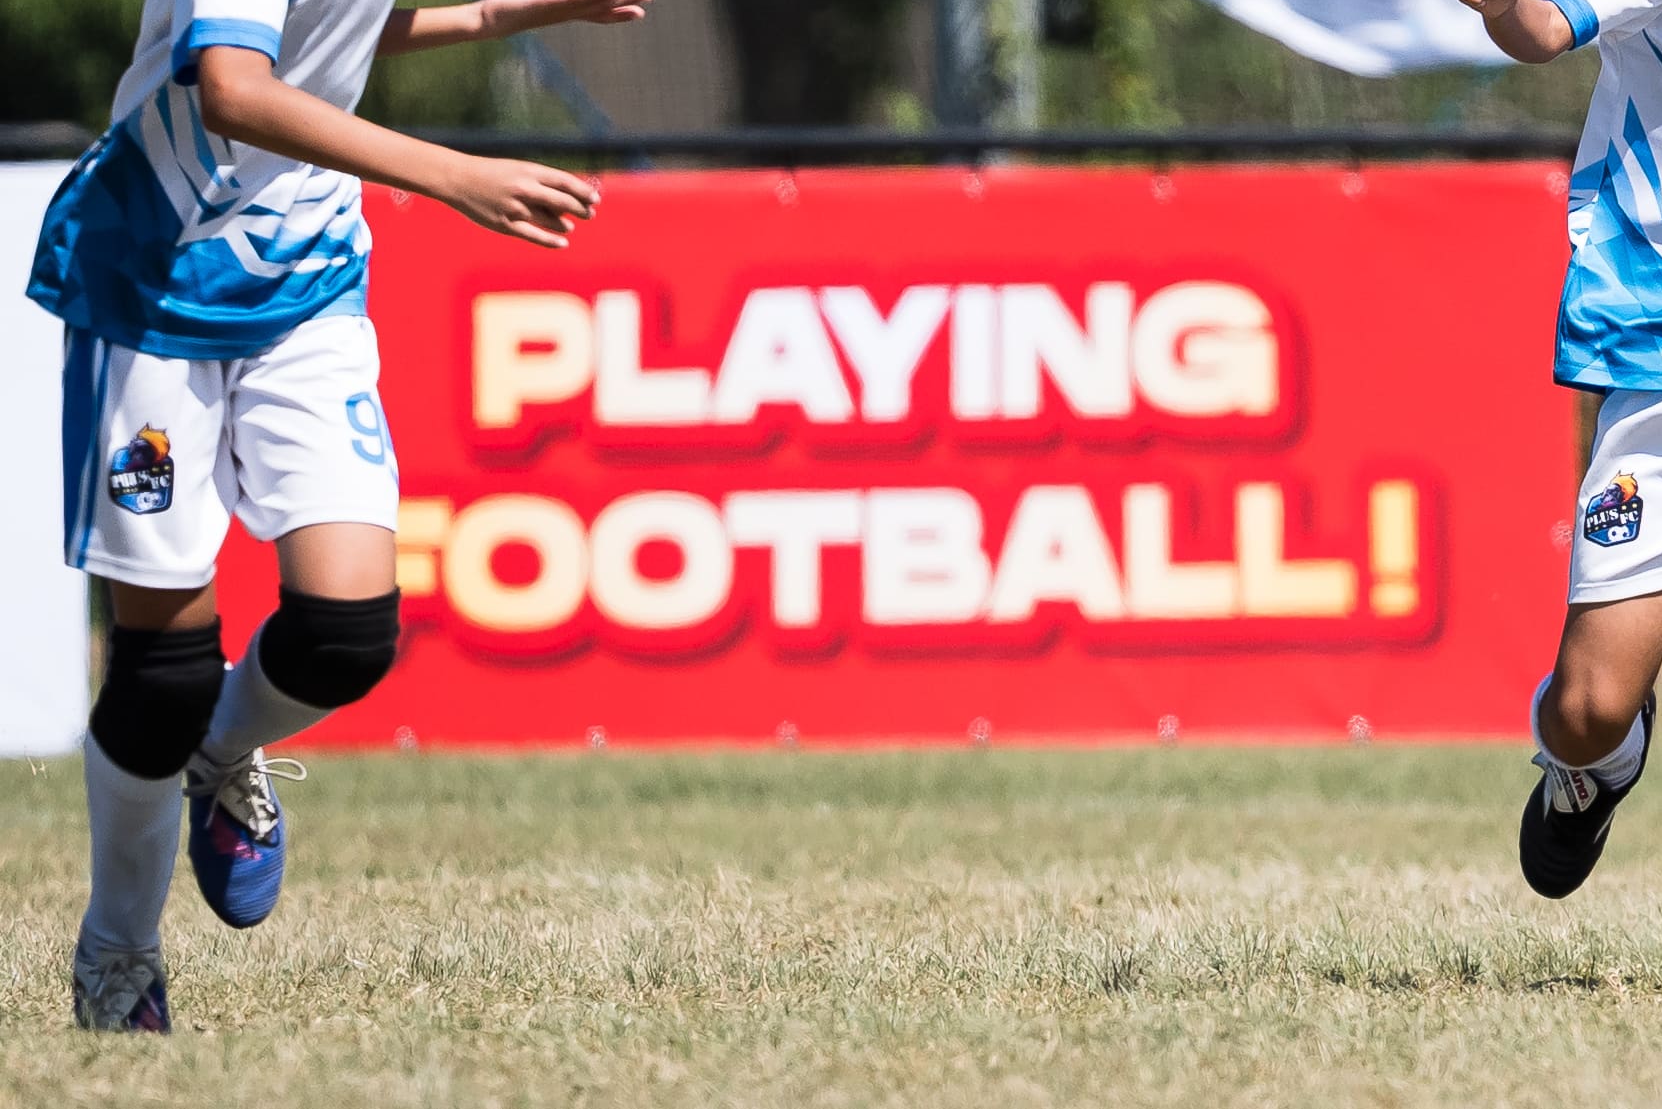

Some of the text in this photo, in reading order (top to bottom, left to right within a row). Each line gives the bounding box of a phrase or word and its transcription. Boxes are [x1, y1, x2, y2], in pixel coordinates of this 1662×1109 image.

[473, 281, 1279, 428] PLAYING
[1586, 508, 1638, 528] PLUS FC
